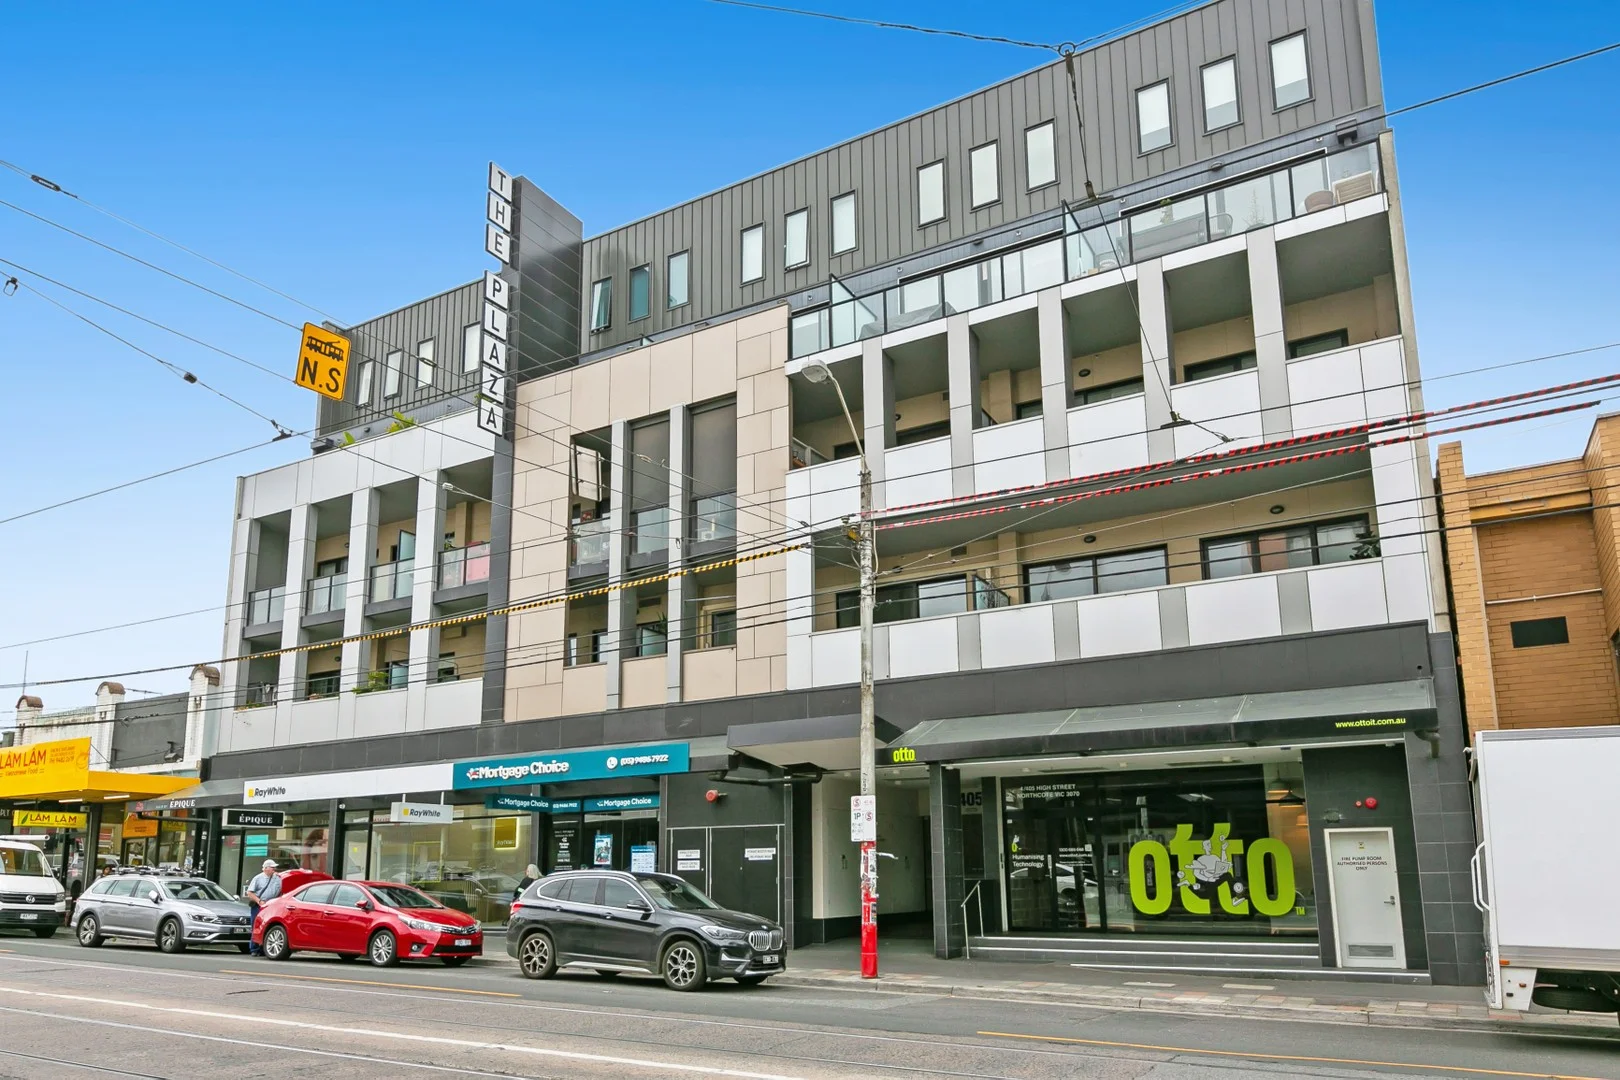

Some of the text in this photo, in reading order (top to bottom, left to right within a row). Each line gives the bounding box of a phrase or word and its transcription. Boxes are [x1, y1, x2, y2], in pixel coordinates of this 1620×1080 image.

[494, 170, 507, 255] THE
[486, 278, 502, 430] PLAZA
[301, 356, 341, 393] N.S
[1335, 717, 1406, 728] www.ottoit.com.au
[479, 759, 570, 779] Mortgage Choice
[504, 797, 549, 809] Mortgage Choice
[603, 797, 651, 808] Mortgage Choice
[239, 813, 273, 825] ÉPIQUE
[1128, 822, 1295, 917] otto
